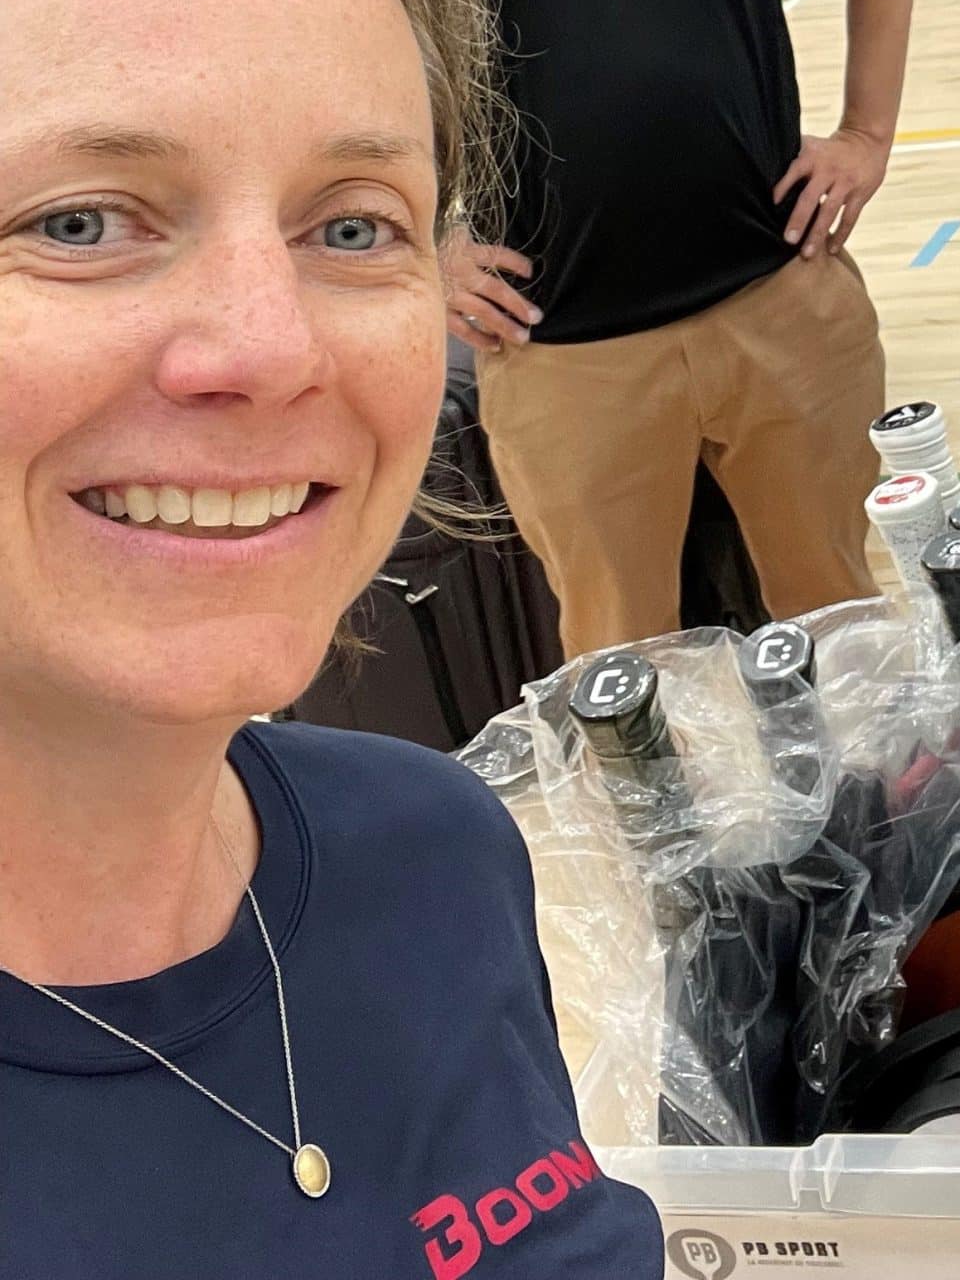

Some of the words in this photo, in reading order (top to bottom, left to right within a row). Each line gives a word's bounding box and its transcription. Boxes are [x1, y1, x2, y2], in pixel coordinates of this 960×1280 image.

[686, 1242, 717, 1264] PB
[742, 1241, 769, 1256] PB
[774, 1242, 840, 1258] SPORT
